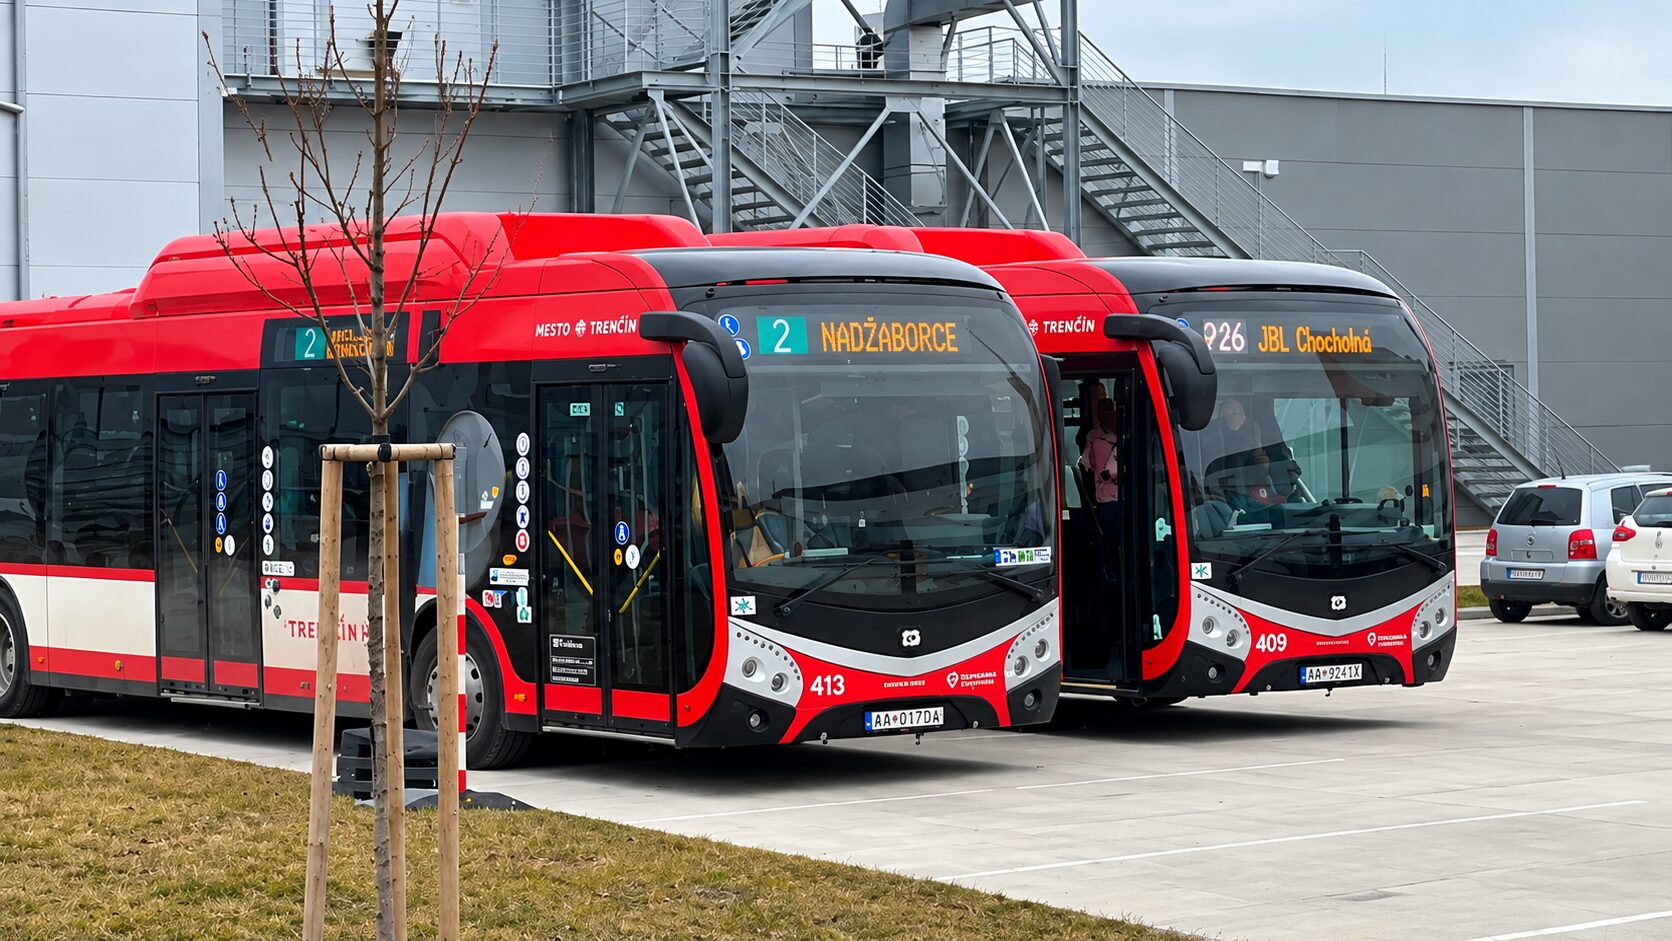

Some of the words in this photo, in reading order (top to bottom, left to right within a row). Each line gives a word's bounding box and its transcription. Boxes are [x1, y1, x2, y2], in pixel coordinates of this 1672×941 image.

[535, 322, 571, 337] MESTO
[590, 315, 637, 335] TRENČÍN
[772, 319, 792, 353] 2
[821, 317, 959, 353] NADŽABORCE
[1043, 315, 1095, 334] TRENČÍN
[304, 328, 317, 358] 2
[1204, 321, 1246, 352] 926
[1258, 325, 1290, 353] JBL
[1296, 326, 1372, 353] Chocholná
[288, 614, 358, 641] TREÍN
[1255, 633, 1288, 653] 409
[809, 674, 846, 696] 413
[1307, 668, 1322, 681] AA
[874, 713, 891, 728] AA
[899, 709, 940, 726] 017DA
